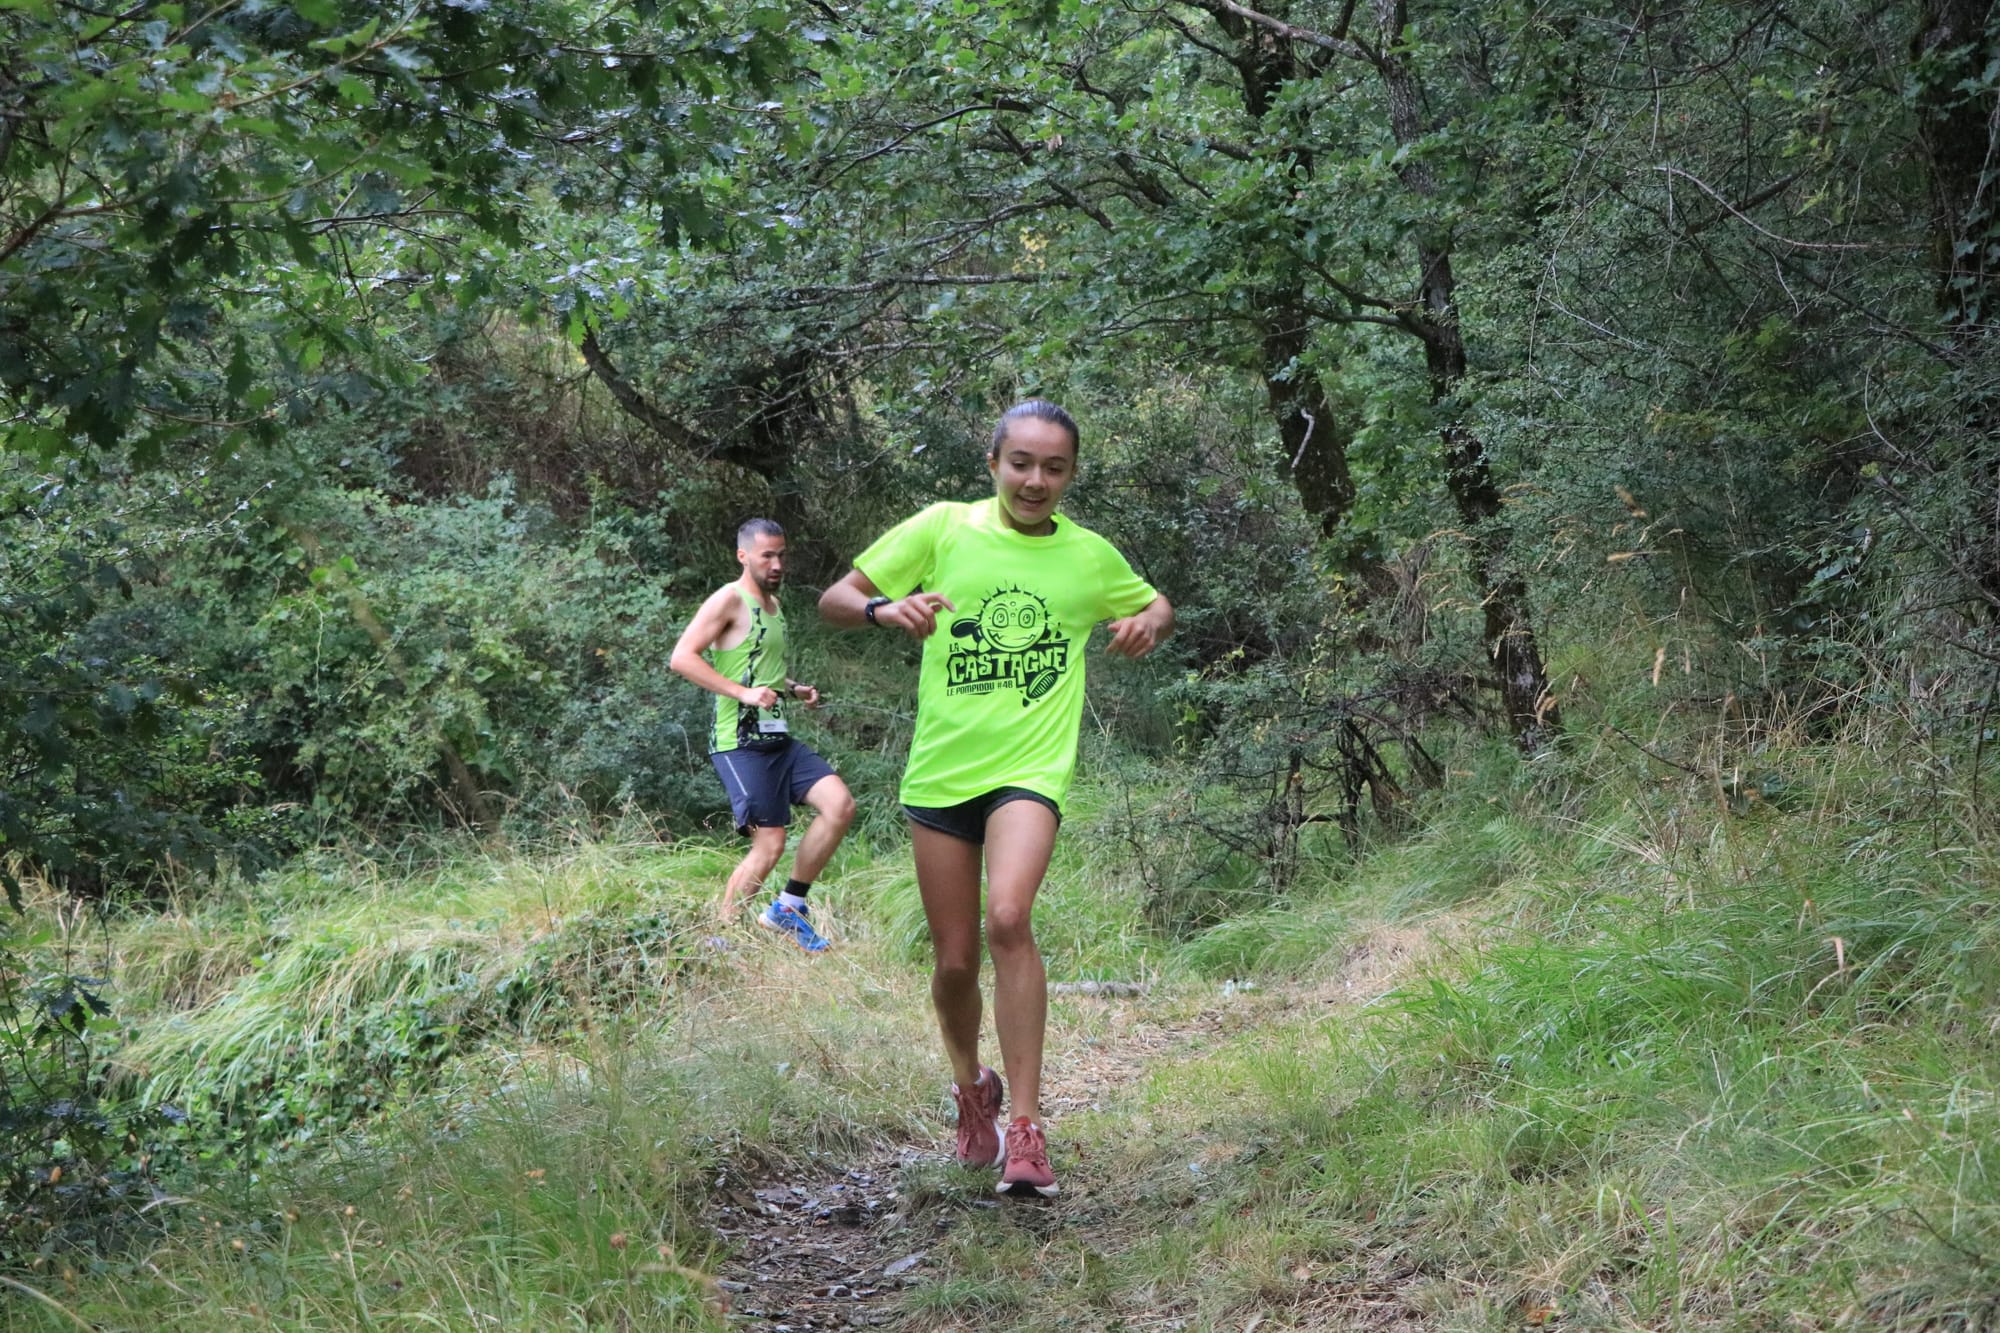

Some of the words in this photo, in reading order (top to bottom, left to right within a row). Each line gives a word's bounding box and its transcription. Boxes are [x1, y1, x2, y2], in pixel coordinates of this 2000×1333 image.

[949, 642, 959, 653] LA
[949, 646, 1066, 686] CASTAGNE
[946, 688, 955, 697] LE
